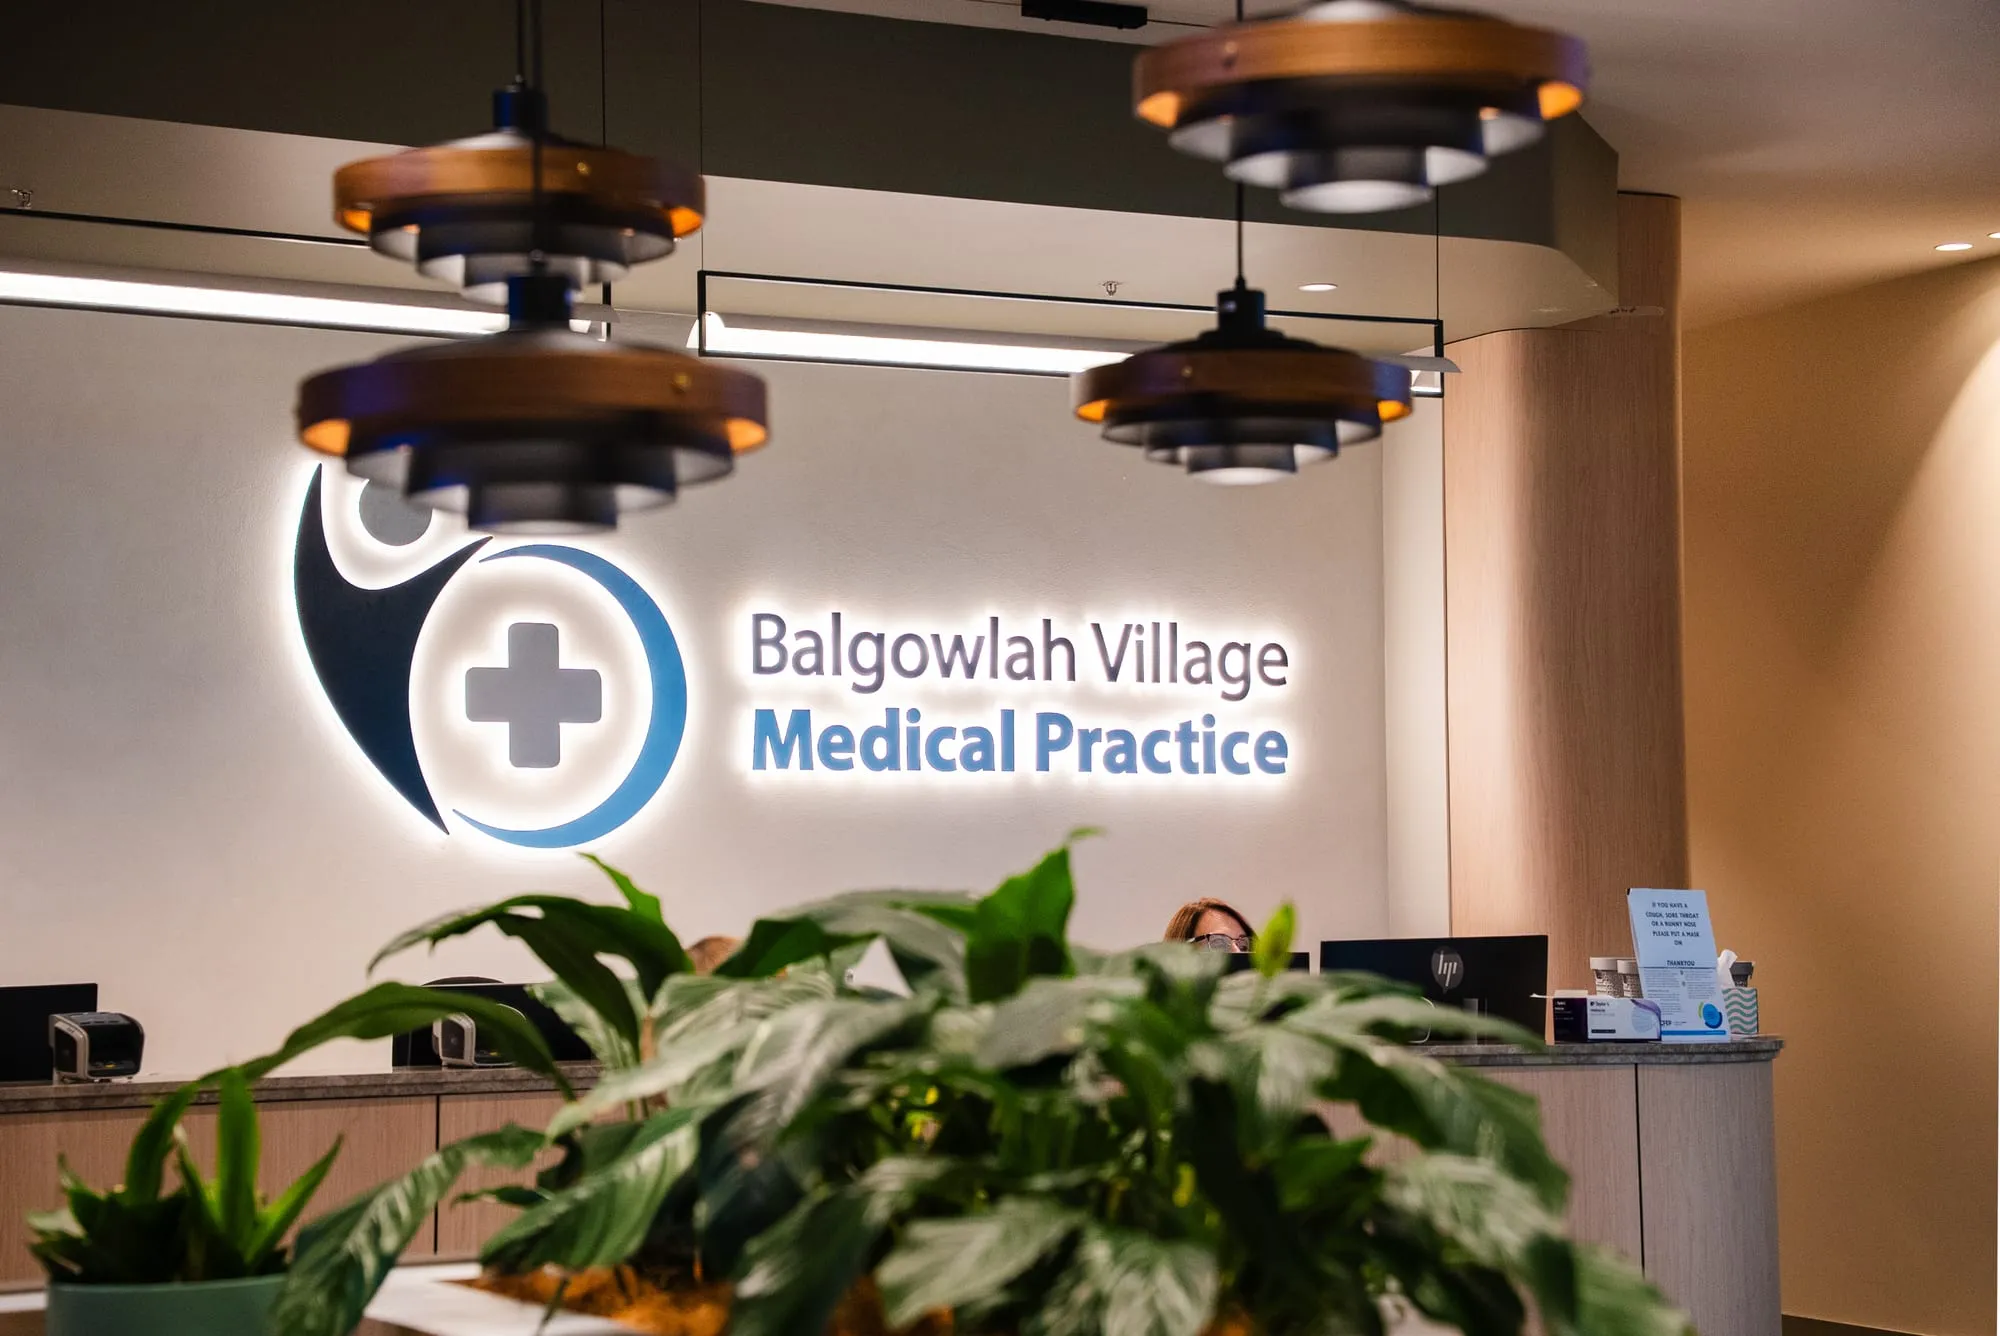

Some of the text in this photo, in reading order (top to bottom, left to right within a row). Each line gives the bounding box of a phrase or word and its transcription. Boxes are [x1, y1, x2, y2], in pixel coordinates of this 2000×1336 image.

[752, 611, 1289, 702] Balgowlah Village
[752, 707, 1289, 776] Medical Practice
[1438, 950, 1457, 994] hp
